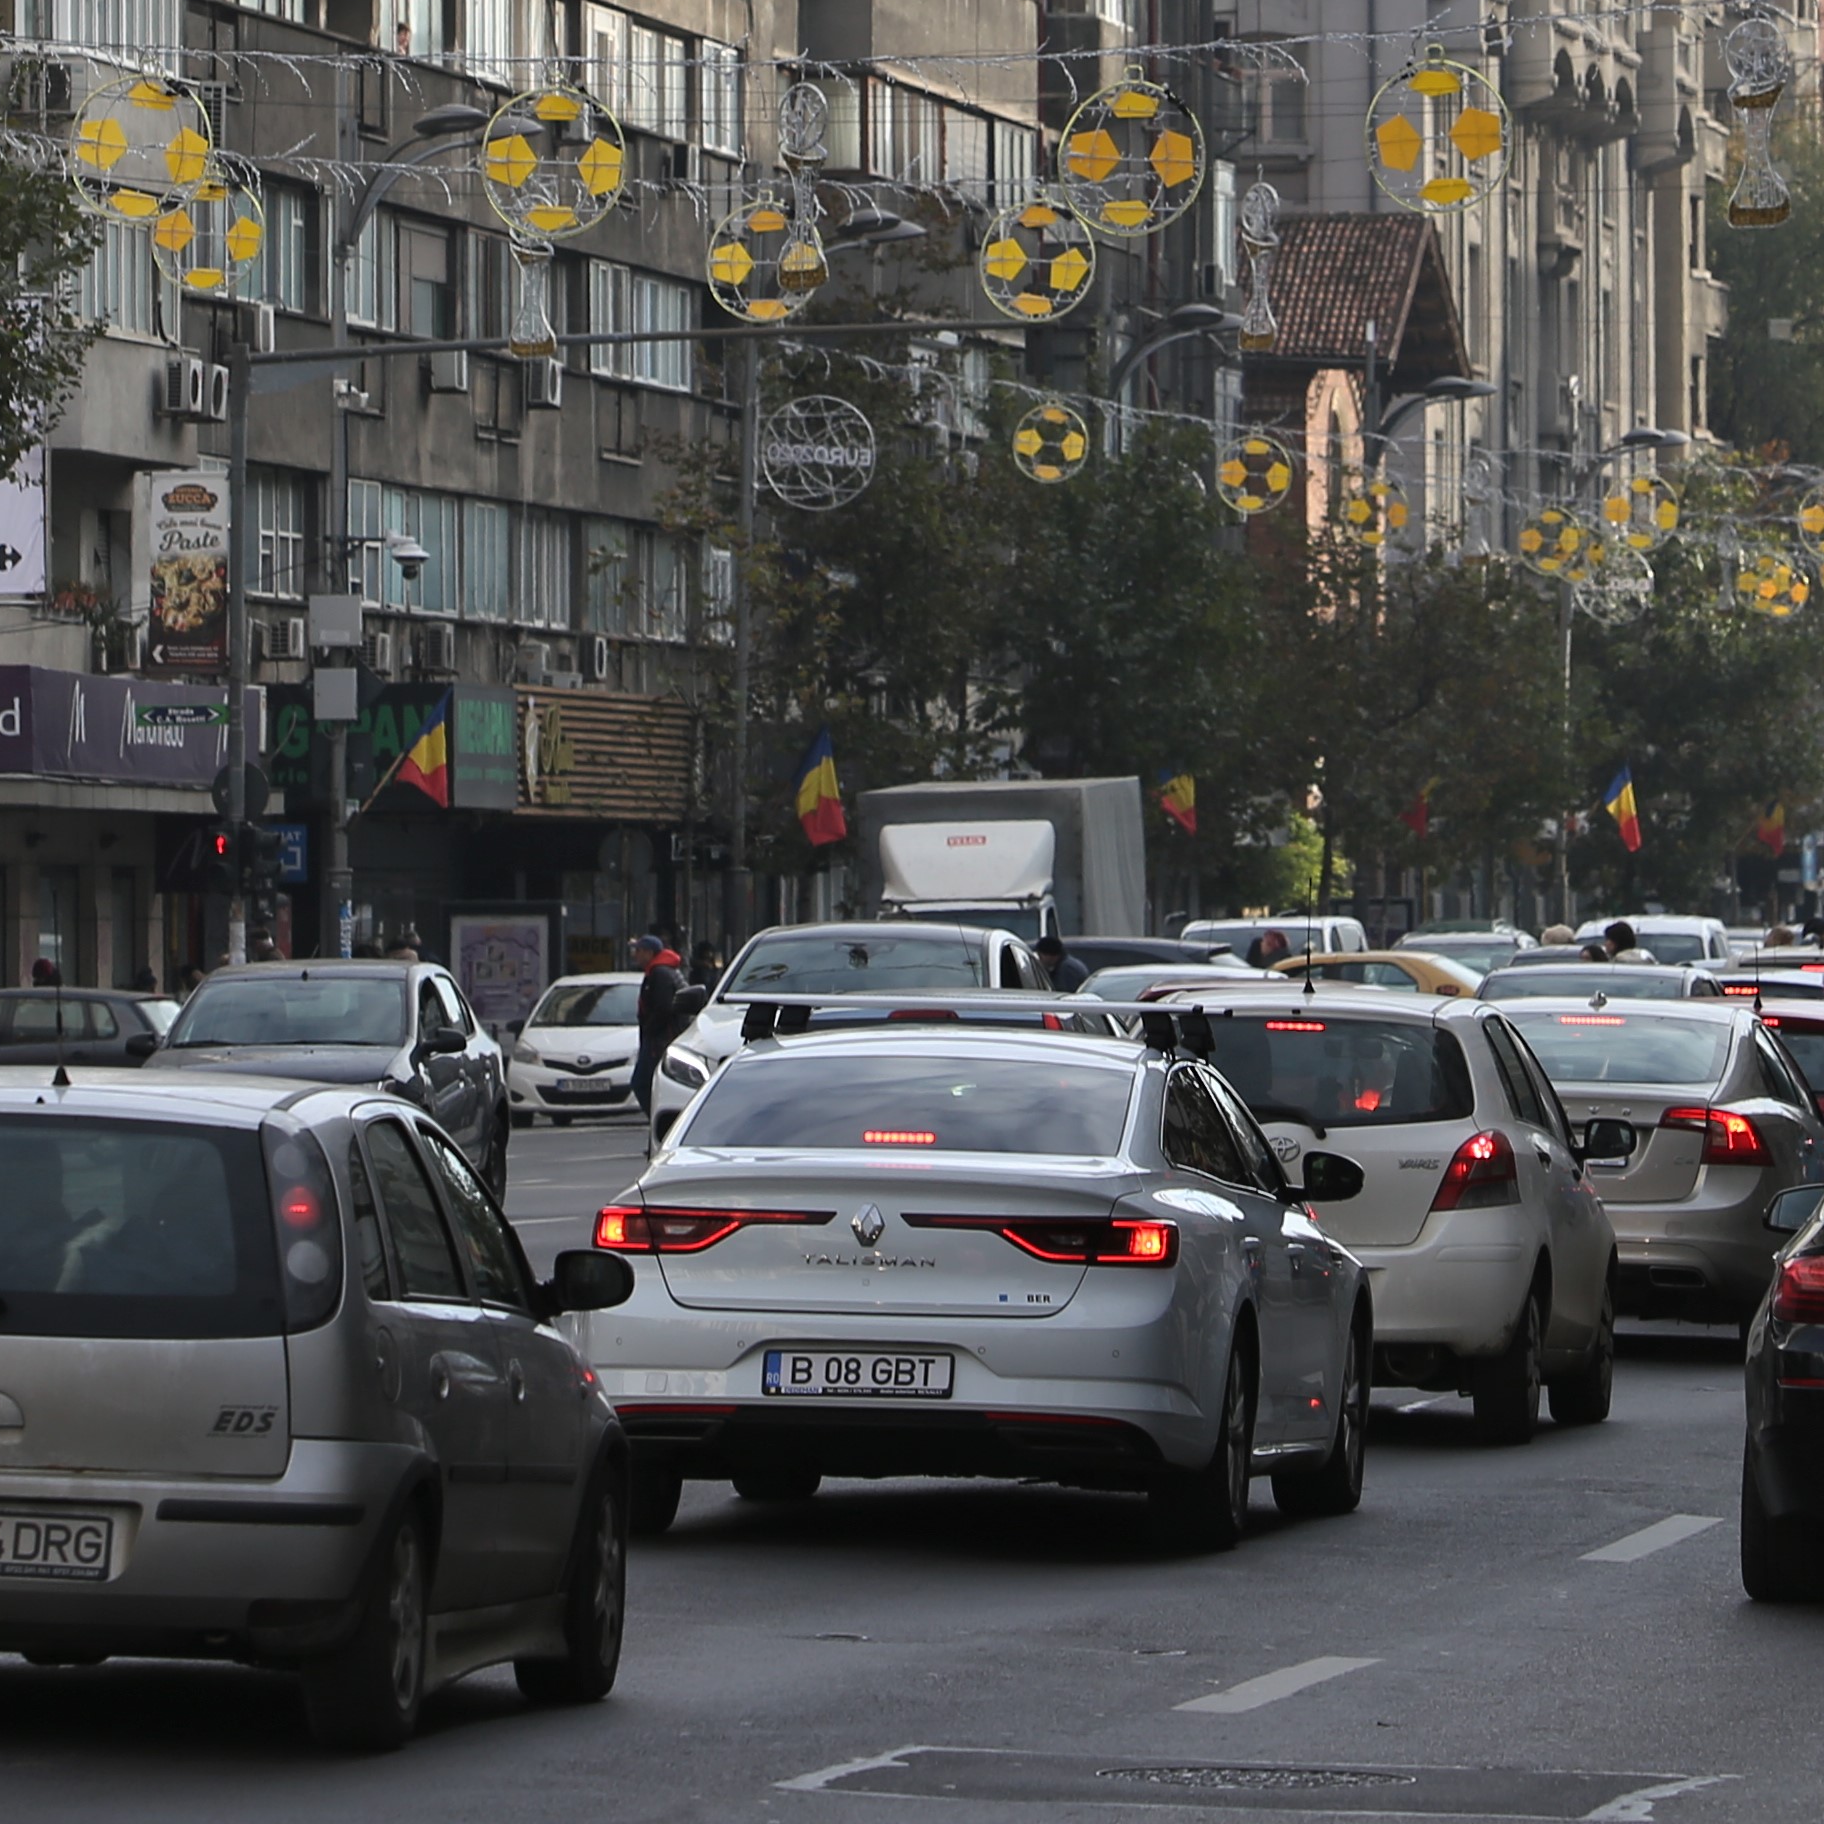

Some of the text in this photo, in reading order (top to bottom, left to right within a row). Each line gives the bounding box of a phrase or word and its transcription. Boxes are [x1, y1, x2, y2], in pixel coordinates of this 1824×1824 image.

[159, 529, 221, 552] Paste
[801, 1252, 937, 1269] TALISMAN
[1027, 1293, 1052, 1304] BER
[790, 1356, 814, 1385] B
[824, 1356, 862, 1385] 08
[871, 1356, 936, 1387] GBT
[212, 1410, 276, 1434] EDS
[11, 1521, 104, 1565] DRG
